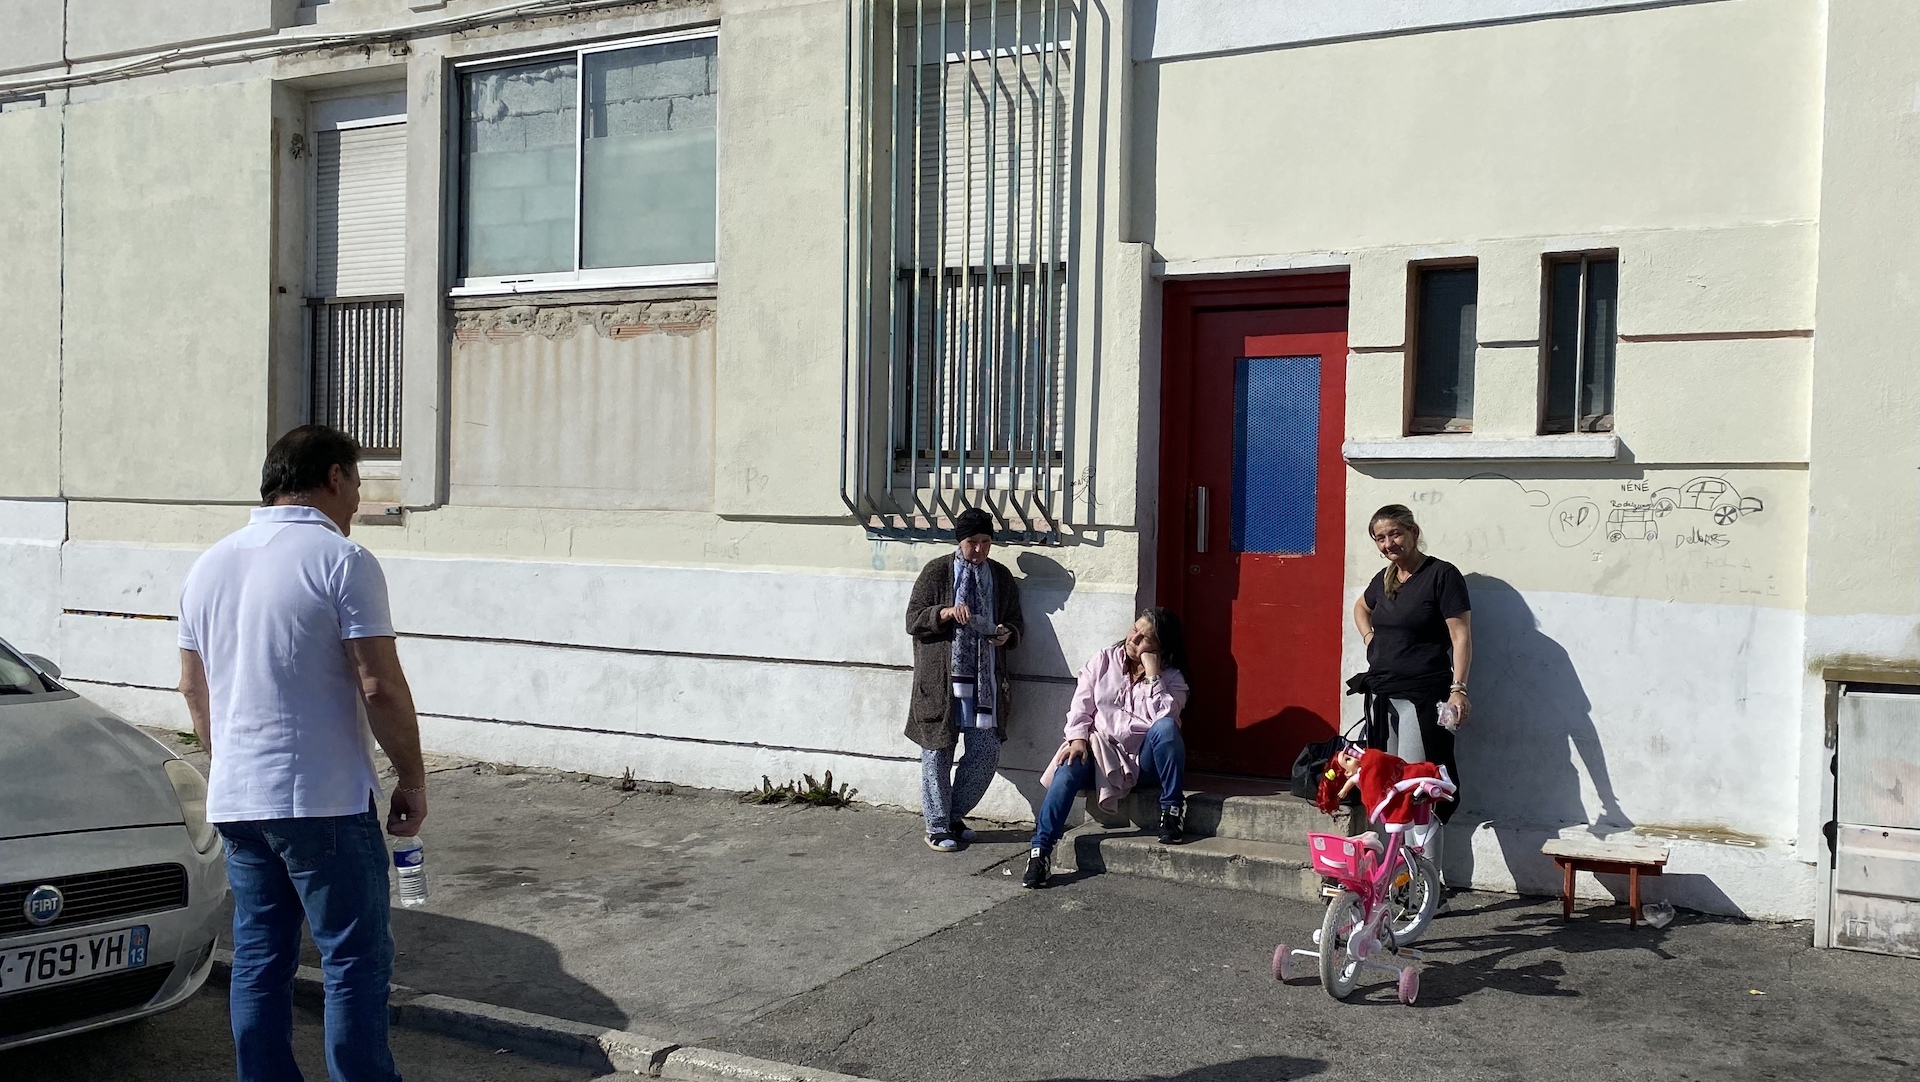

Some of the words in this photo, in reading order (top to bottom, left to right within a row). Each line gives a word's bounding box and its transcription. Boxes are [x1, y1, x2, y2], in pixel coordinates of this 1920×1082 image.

[1621, 479, 1650, 492] NÉNÉ
[31, 897, 58, 913] FIAT
[0, 934, 125, 988] -769-YH
[130, 948, 144, 964] 13
